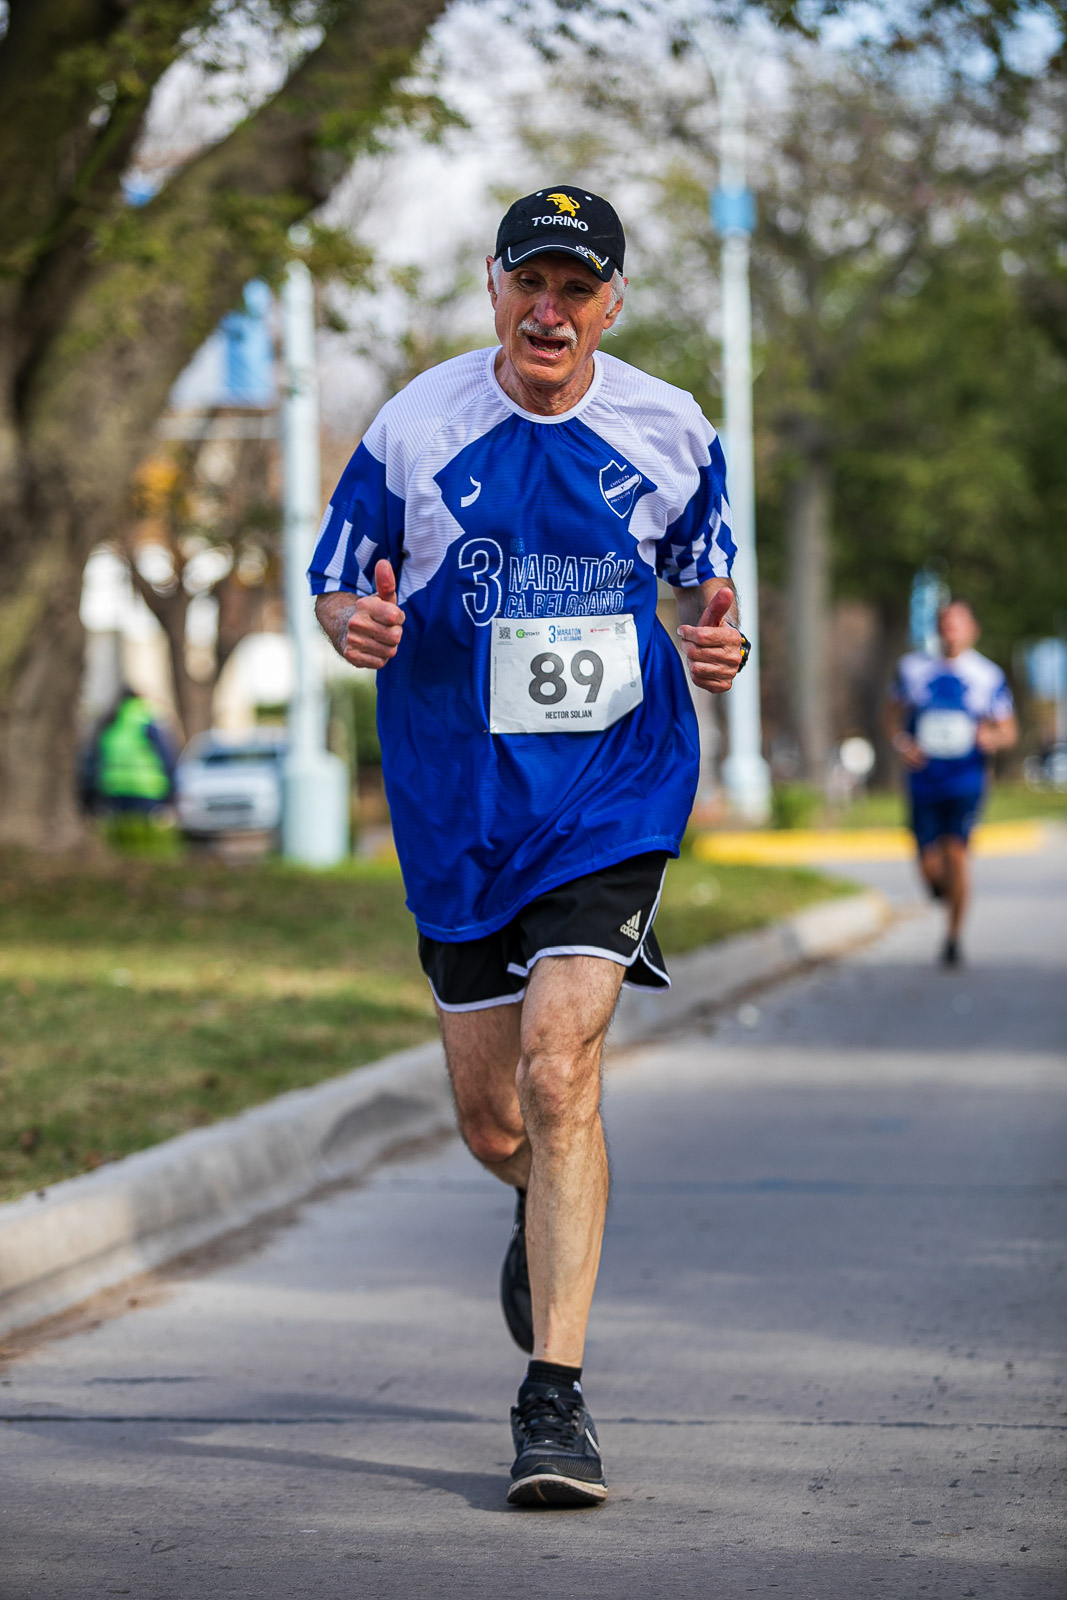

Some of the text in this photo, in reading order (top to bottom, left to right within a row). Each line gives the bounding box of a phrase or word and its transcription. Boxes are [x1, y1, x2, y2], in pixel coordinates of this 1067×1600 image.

[532, 215, 589, 232] TORINO
[458, 537, 634, 627] 3 MARATÓN
[548, 625, 556, 643] 3
[528, 649, 604, 706] 89
[545, 710, 570, 719] HECTOR
[619, 923, 640, 941] adidas
